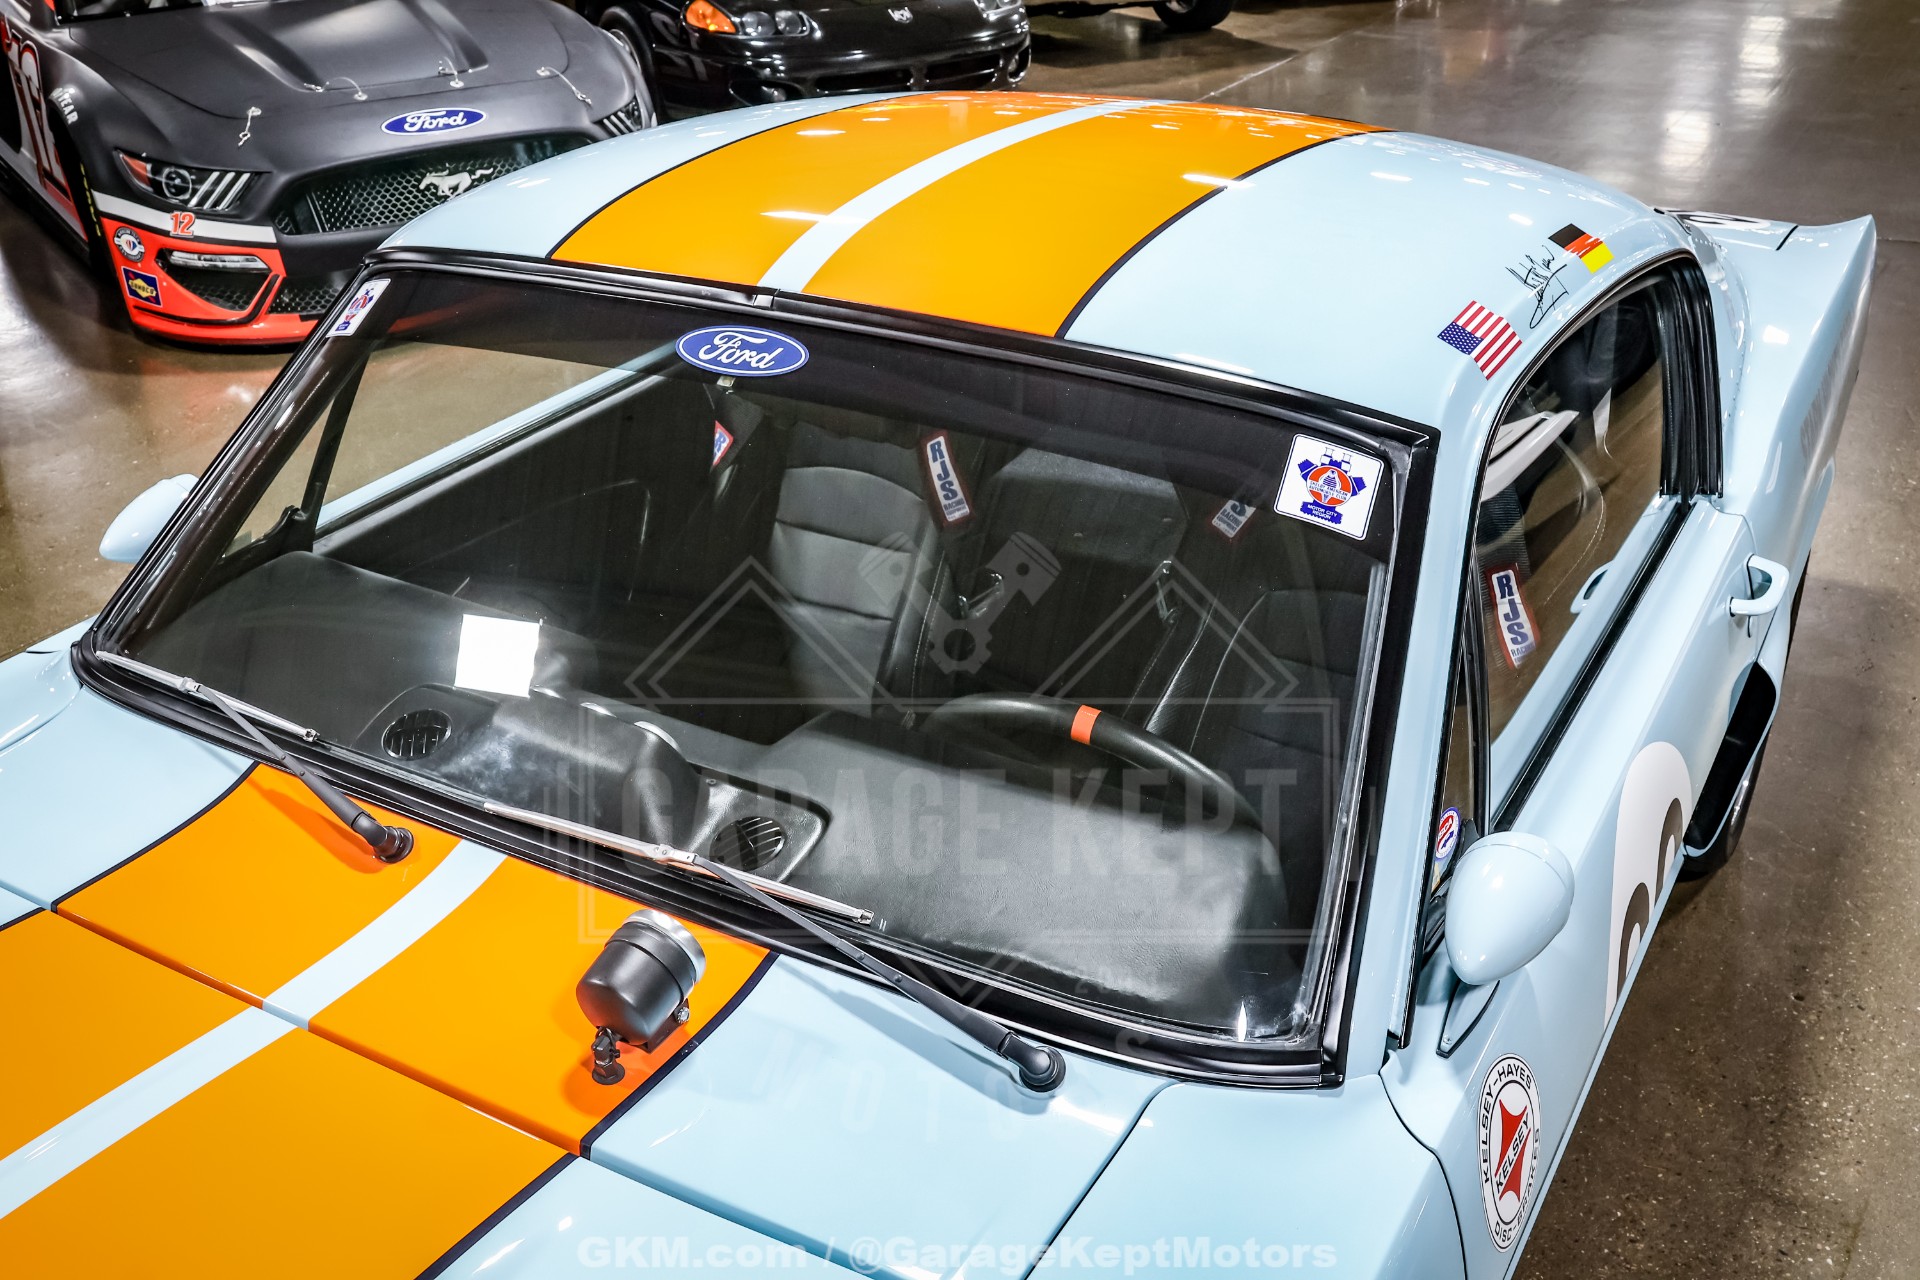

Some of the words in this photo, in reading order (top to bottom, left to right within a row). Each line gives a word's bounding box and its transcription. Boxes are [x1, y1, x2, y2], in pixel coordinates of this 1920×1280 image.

[403, 110, 467, 132] Ford
[170, 211, 196, 237] 12
[698, 331, 784, 369] Ford
[929, 440, 959, 501] RJS
[1496, 573, 1529, 646] RJS
[1496, 1112, 1531, 1194] KELSEY
